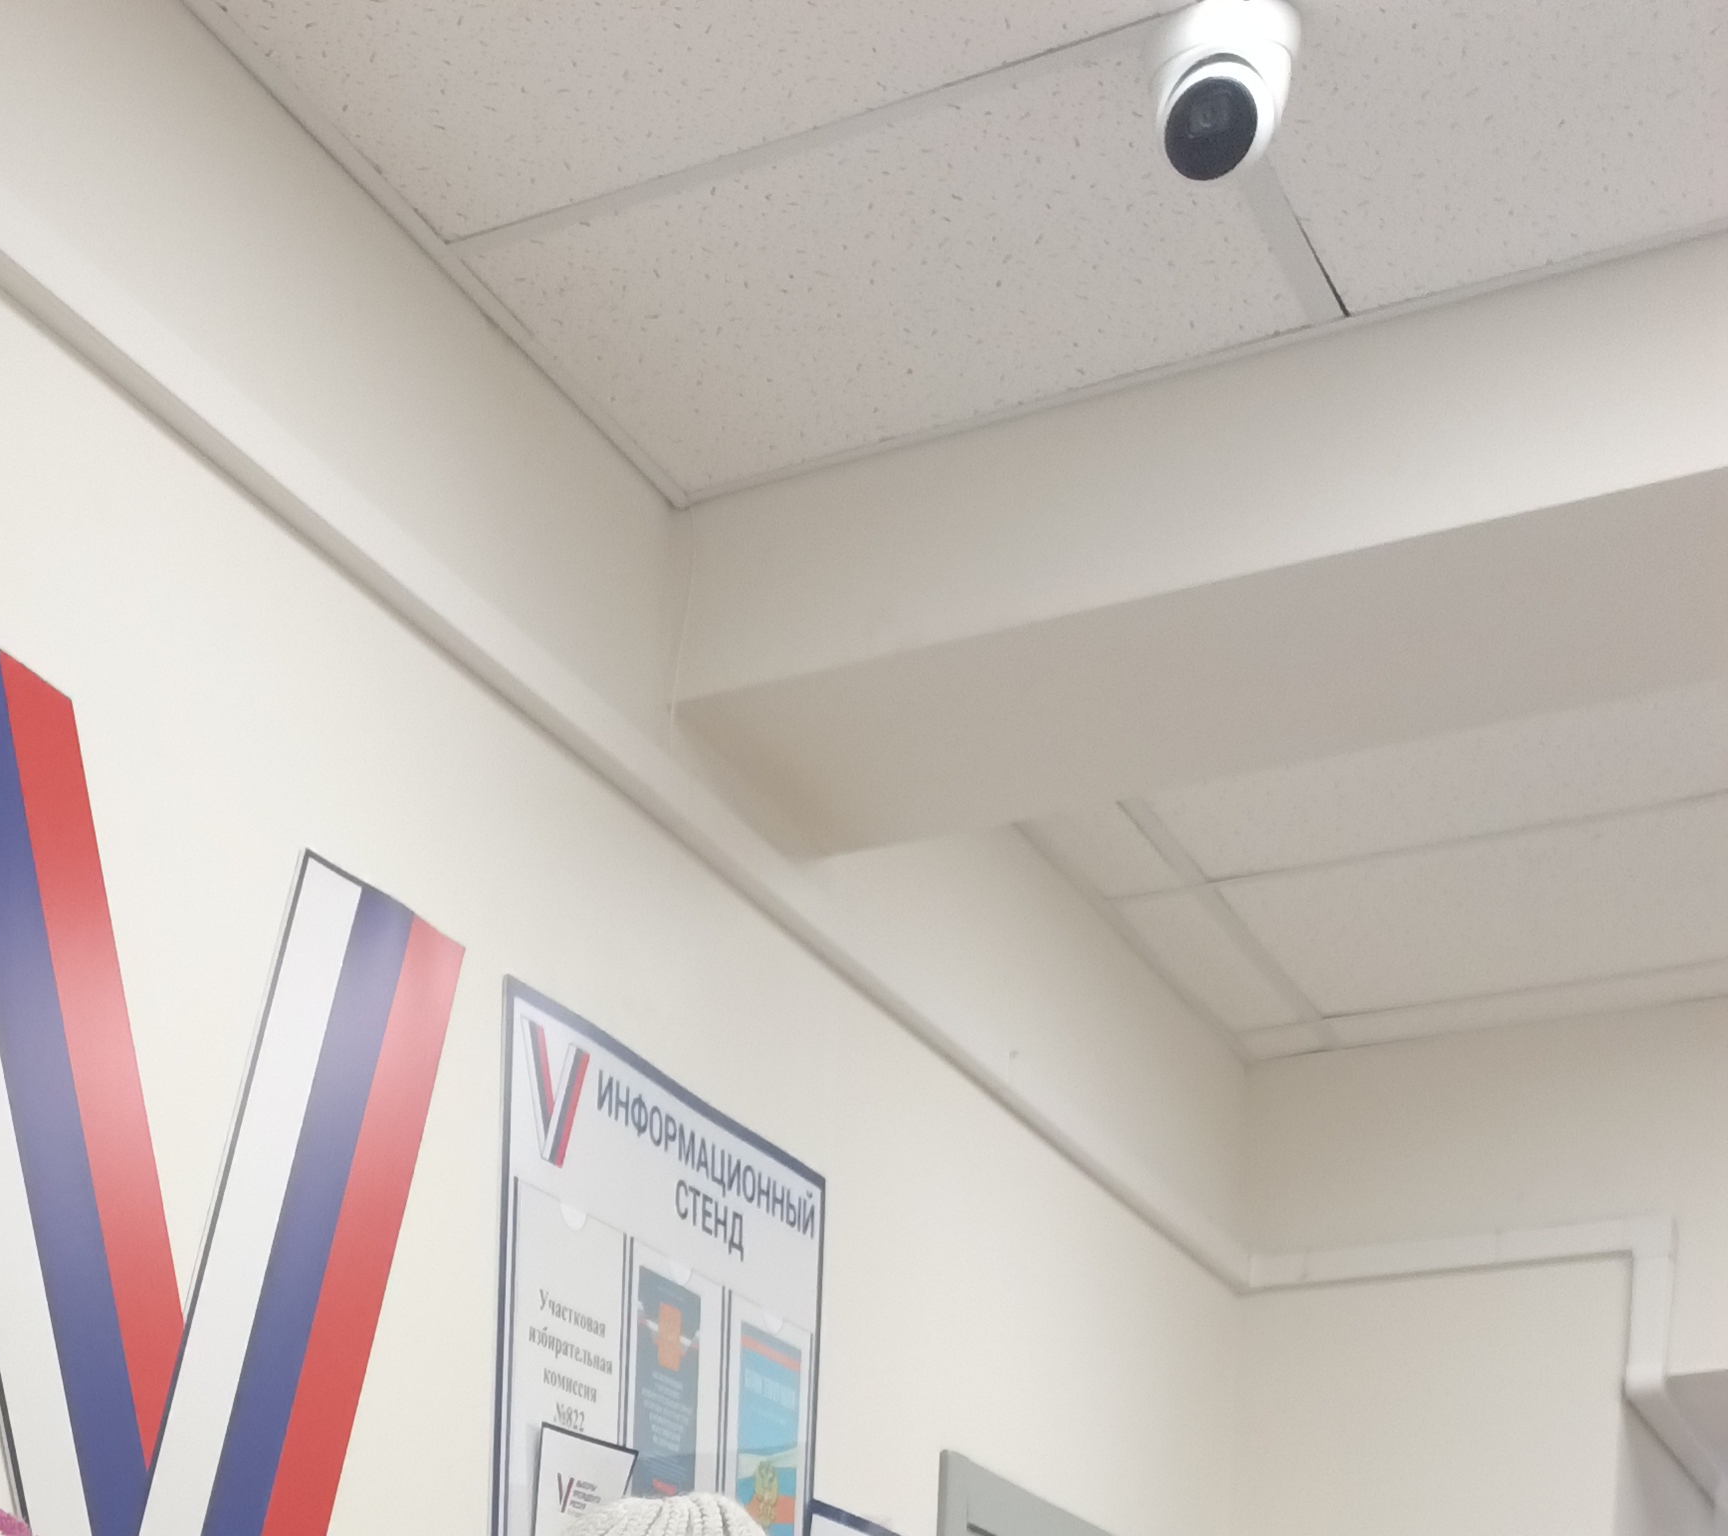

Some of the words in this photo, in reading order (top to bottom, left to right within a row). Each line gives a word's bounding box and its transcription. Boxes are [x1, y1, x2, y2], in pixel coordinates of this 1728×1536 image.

[596, 1069, 816, 1240] ИНФОРМАЦИОННЫЙ
[674, 1179, 745, 1262] СТЕНД
[539, 1288, 606, 1338] Участковая
[528, 1325, 613, 1375] избирательная
[543, 1367, 597, 1403] комиссия
[553, 1402, 585, 1432] №822
